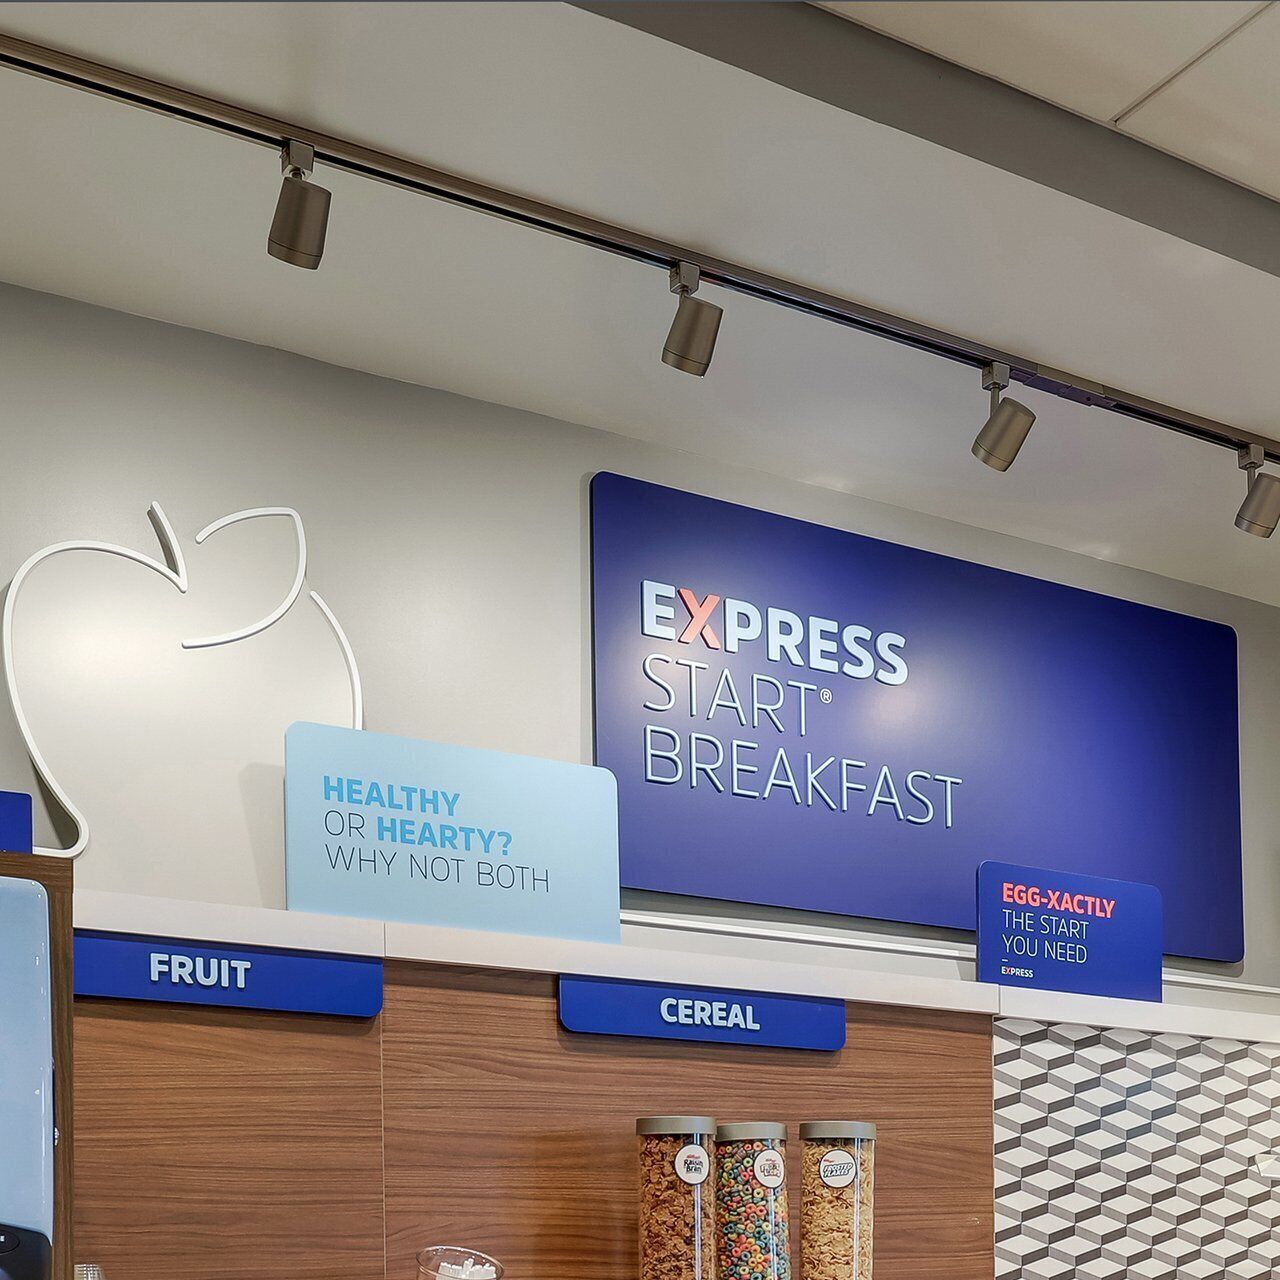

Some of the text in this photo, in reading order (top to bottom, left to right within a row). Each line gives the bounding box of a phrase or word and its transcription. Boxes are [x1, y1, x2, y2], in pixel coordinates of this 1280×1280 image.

[640, 578, 910, 687] EXPRESS
[643, 723, 963, 829] BREAKFAST
[323, 774, 461, 817] HEALTHY
[324, 810, 513, 857] OR HEARTY?
[325, 842, 551, 894] WHY NOT BOTH
[1002, 882, 1116, 919] EGG-XACTLY
[1002, 909, 1090, 940] THE START
[1002, 933, 1088, 964] YOU NEED
[149, 952, 253, 990] FRUIT
[1001, 966, 1034, 979] EXPRESS
[659, 997, 761, 1032] CEREAL
